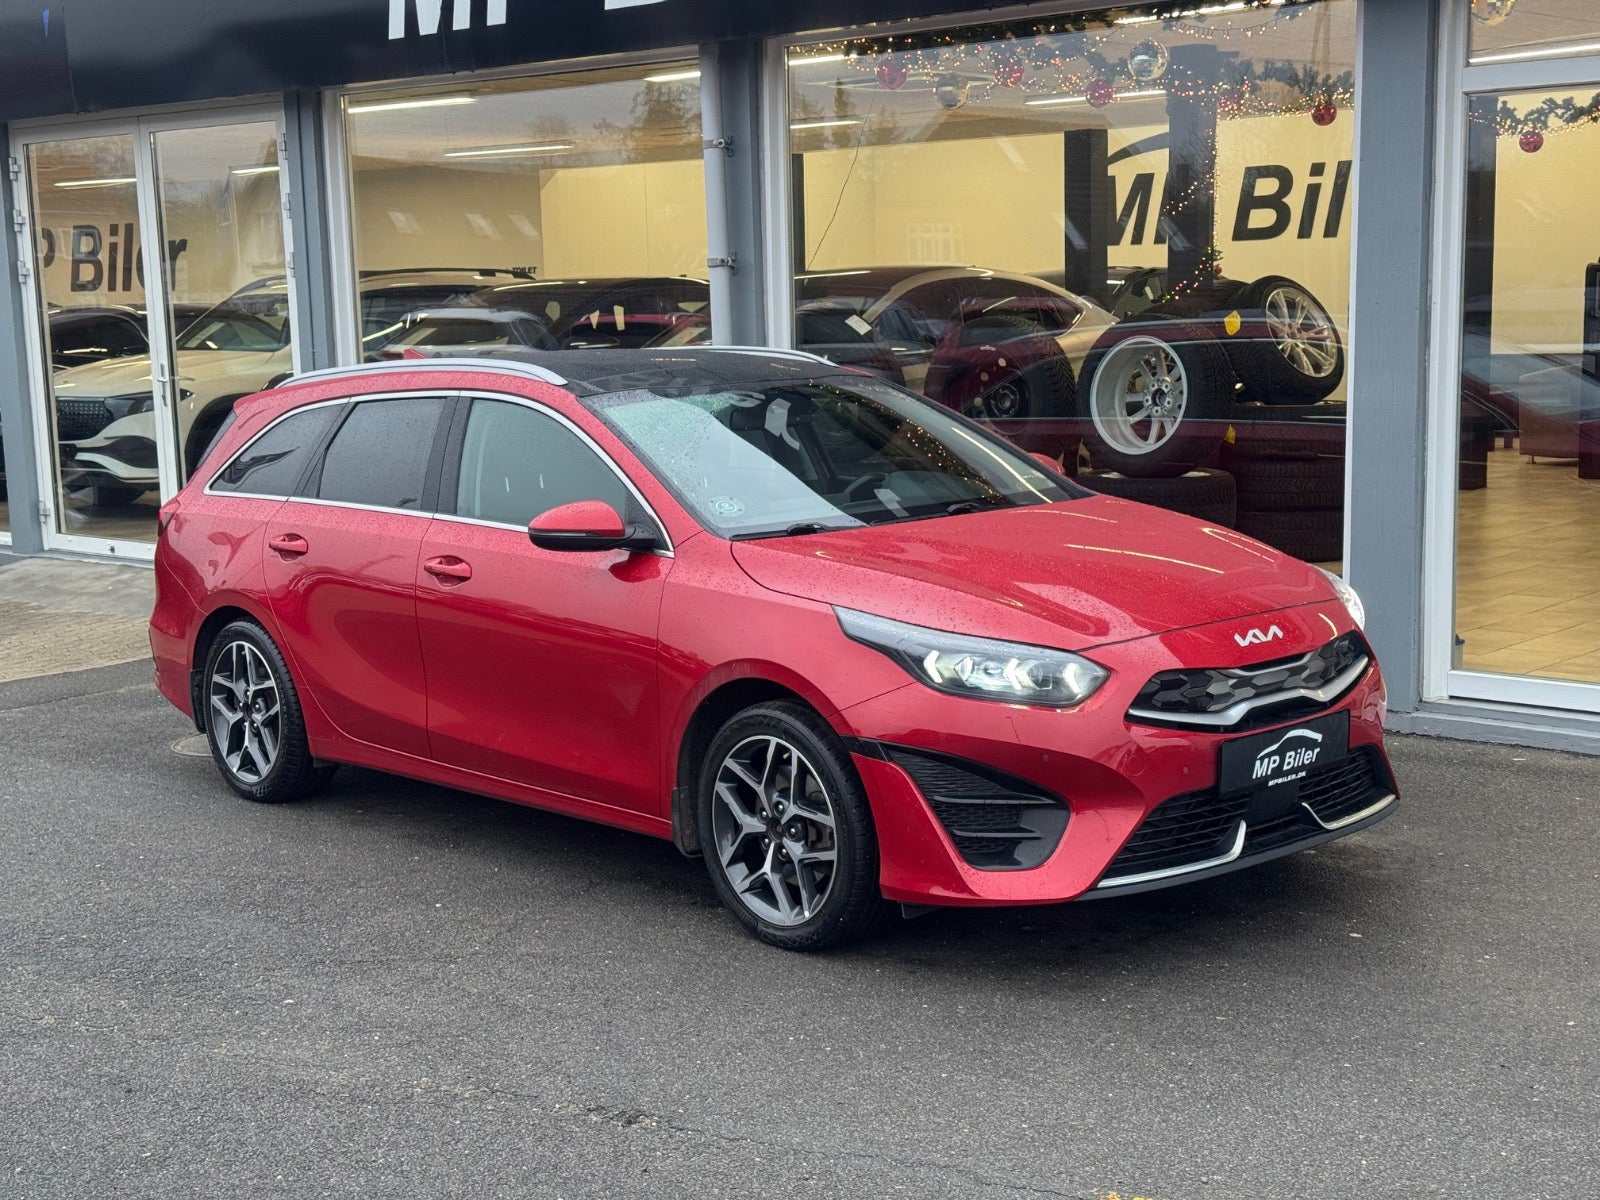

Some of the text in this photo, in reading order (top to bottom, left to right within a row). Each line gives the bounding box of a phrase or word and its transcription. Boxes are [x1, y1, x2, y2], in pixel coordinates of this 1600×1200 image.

[70, 222, 188, 293] Bilr
[1233, 625, 1283, 647] KIA
[1252, 747, 1321, 779] MP Biler
[1267, 770, 1307, 787] MPBILER.DK
